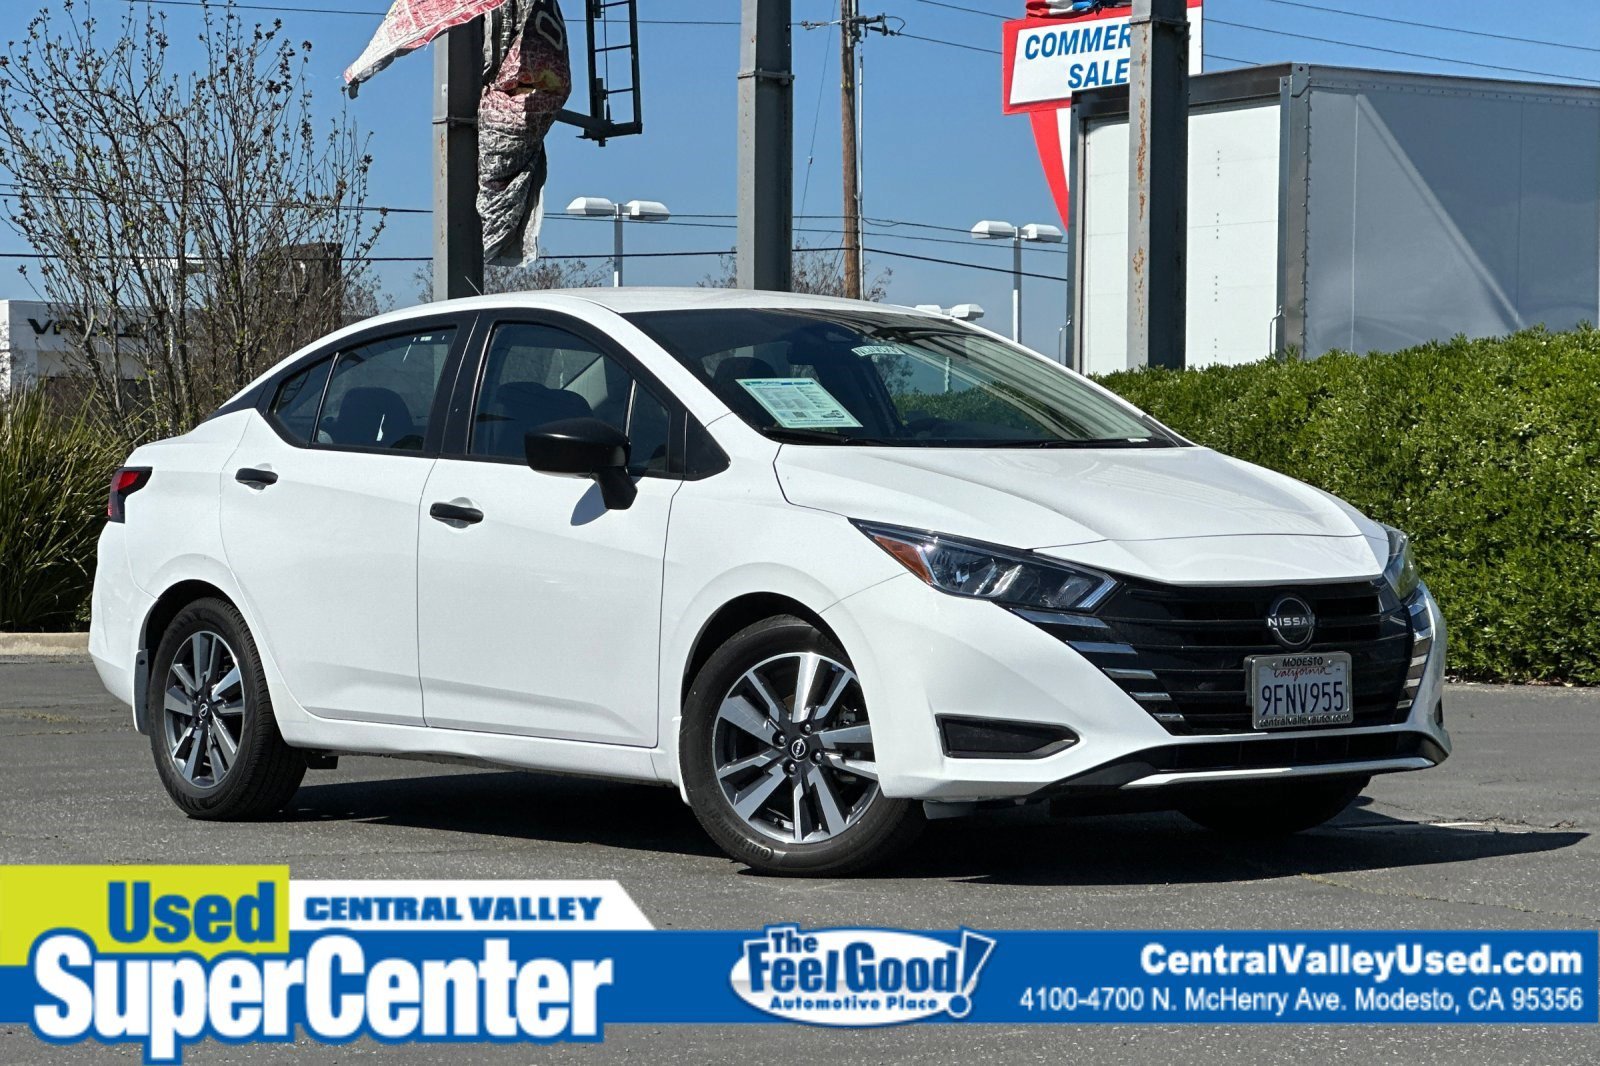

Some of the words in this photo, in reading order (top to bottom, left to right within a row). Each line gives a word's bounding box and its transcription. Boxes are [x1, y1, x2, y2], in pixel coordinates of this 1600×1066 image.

[1267, 616, 1315, 627] NISSAN
[1282, 656, 1324, 667] MODESTO
[1273, 666, 1332, 681] California
[1261, 681, 1344, 716] 9FNV955
